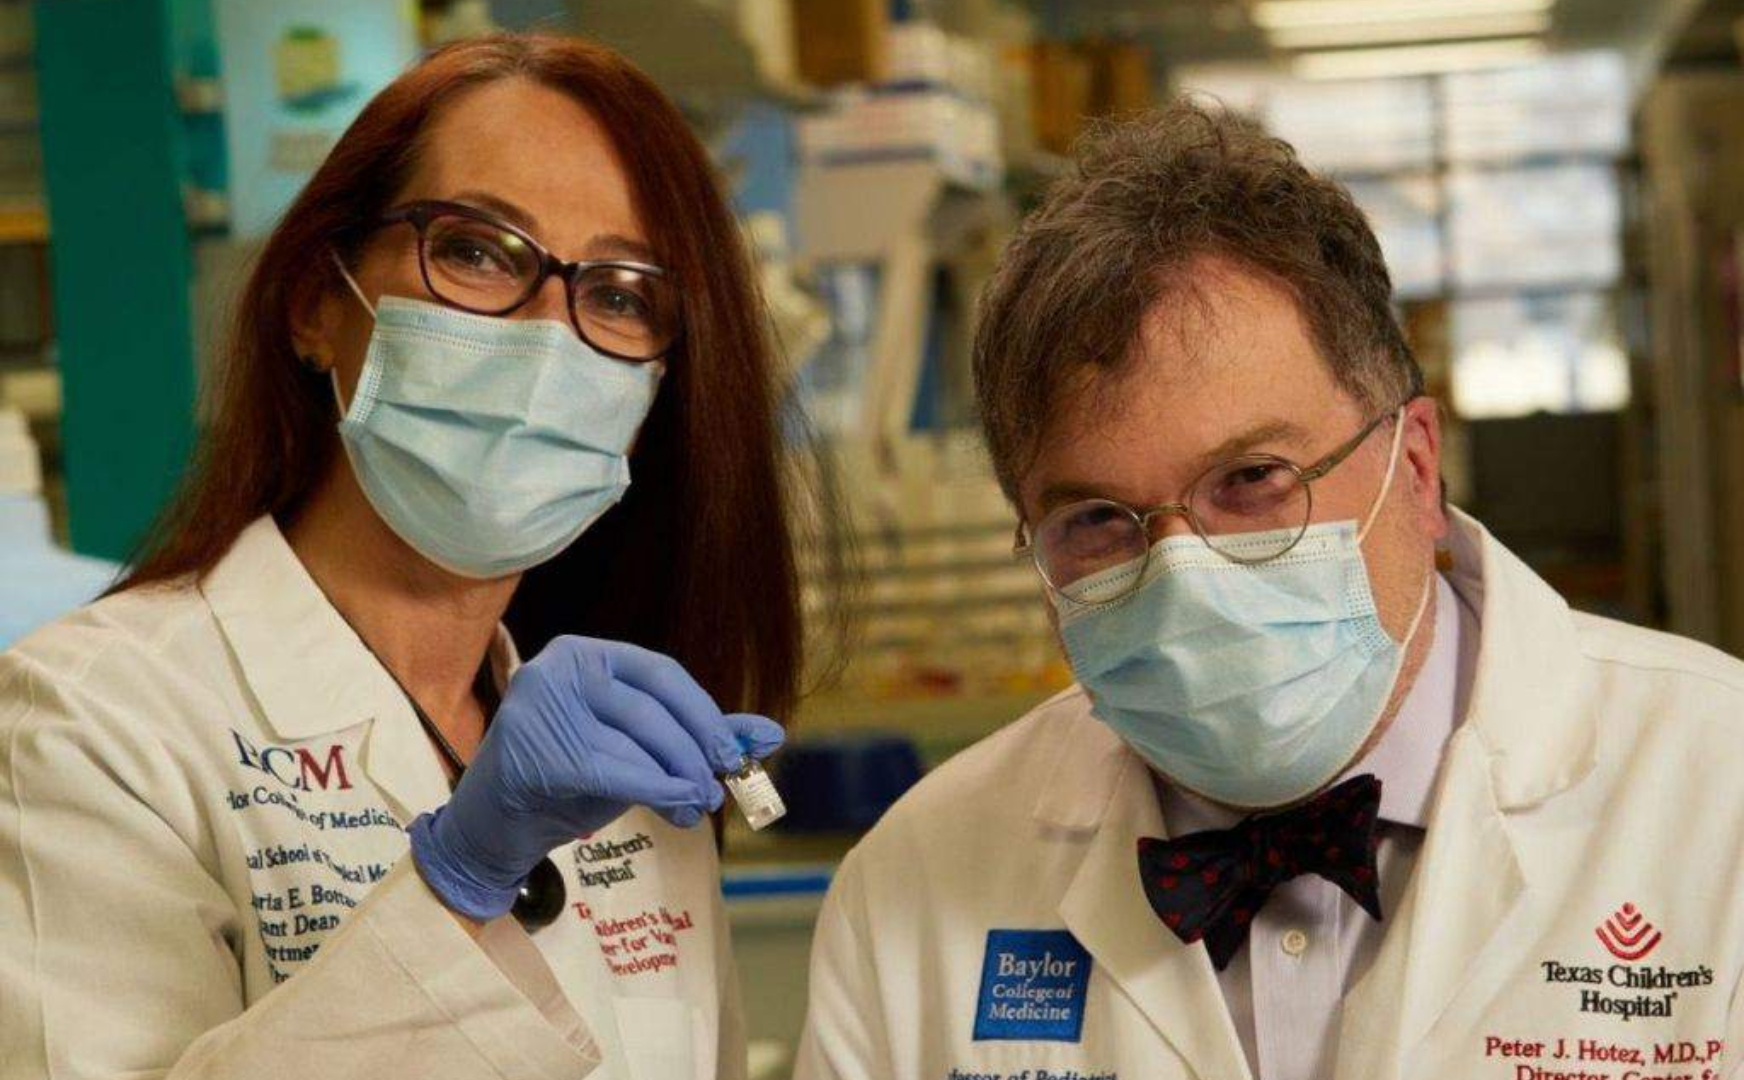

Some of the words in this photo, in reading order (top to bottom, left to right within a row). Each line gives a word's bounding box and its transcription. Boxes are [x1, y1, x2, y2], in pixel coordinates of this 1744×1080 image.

[265, 844, 310, 868] School
[622, 936, 648, 953] for
[997, 951, 1077, 982] Baylor
[1542, 961, 1602, 983] Texas
[1608, 964, 1713, 989] Children's
[988, 1002, 1071, 1021] Medicine
[1485, 1036, 1545, 1058] Peter
[1553, 1038, 1570, 1060] J.
[1578, 1039, 1645, 1066] Hotez,
